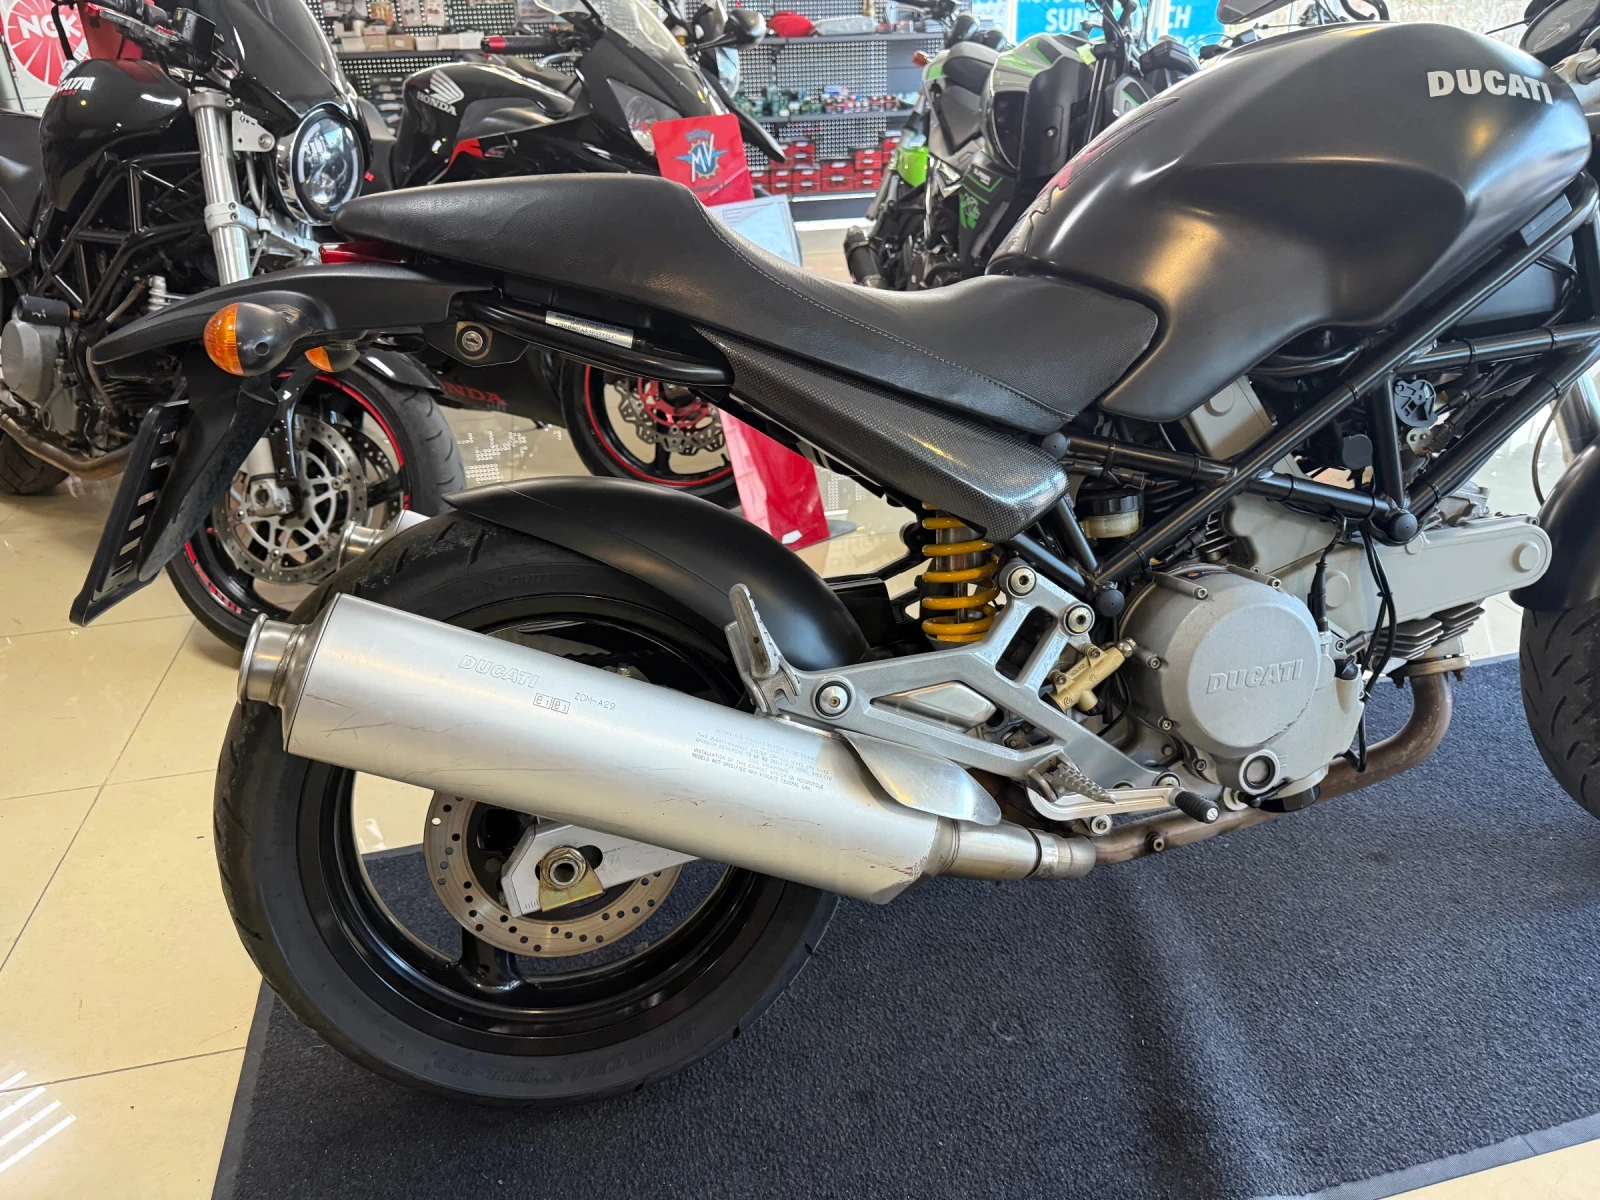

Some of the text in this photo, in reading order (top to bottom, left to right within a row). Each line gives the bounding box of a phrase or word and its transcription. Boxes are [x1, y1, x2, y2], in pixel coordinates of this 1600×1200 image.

[17, 13, 82, 39] NGK
[1427, 69, 1553, 105] DUCATI
[416, 91, 457, 117] HONDA
[691, 133, 715, 183] MV
[439, 380, 508, 407] NDA
[458, 655, 540, 688] DUCATI
[1206, 659, 1303, 694] DUCATI
[574, 692, 617, 711] ZDM-A29
[692, 753, 710, 762] MODELS
[694, 748, 726, 761] INSTALLATION
